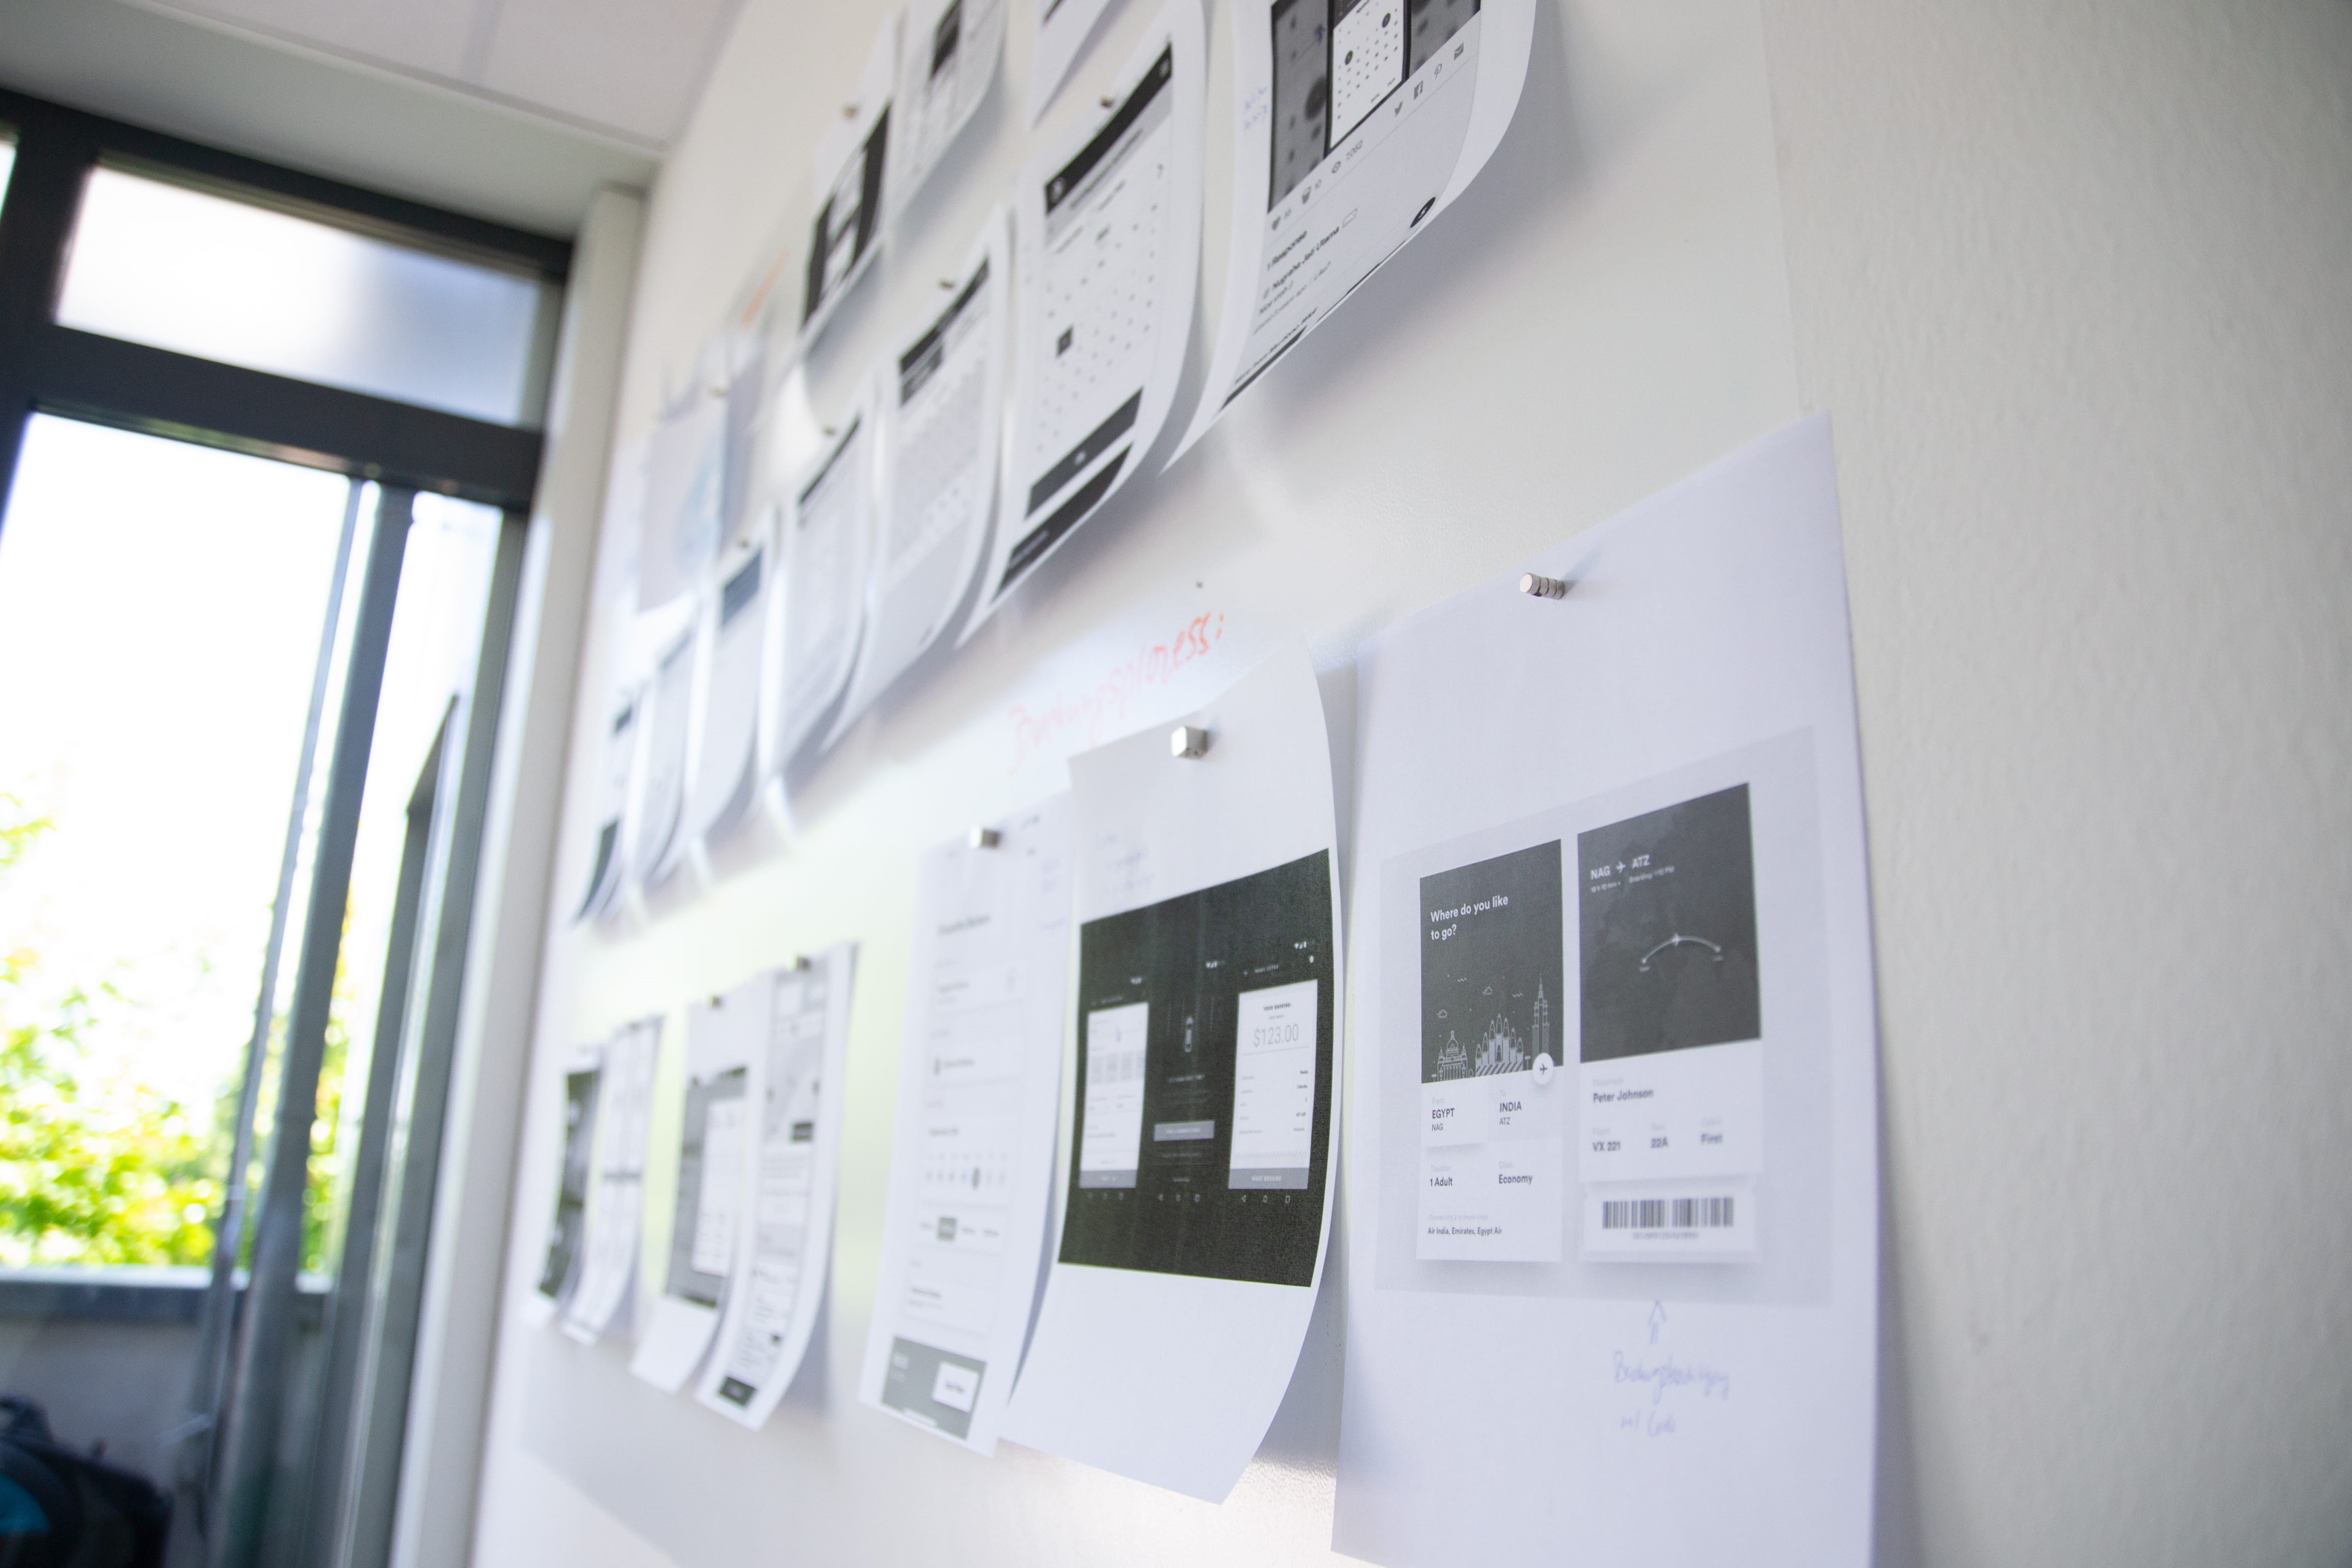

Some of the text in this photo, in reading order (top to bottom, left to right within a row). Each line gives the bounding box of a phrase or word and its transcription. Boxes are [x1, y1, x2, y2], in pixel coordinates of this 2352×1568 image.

[1590, 854, 1650, 880] NAG ATZ
[1430, 895, 1508, 922] Where do you like
[1431, 924, 1457, 941] to go?
[1254, 1023, 1299, 1048] $123.00
[1593, 1090, 1654, 1104] Peter Johnson
[1500, 1101, 1522, 1112] INDIA
[1432, 1108, 1455, 1119] EGYPT
[1499, 1117, 1511, 1125] ATZ
[1431, 1123, 1444, 1132] NAG
[1592, 1142, 1605, 1152] VX
[1607, 1141, 1621, 1152] 221
[1430, 1177, 1453, 1187] 1 Adult
[1499, 1174, 1533, 1185] Economy
[1436, 1227, 1451, 1235] India,
[1452, 1227, 1476, 1235] Emirates,
[1478, 1227, 1493, 1236] Egypt
